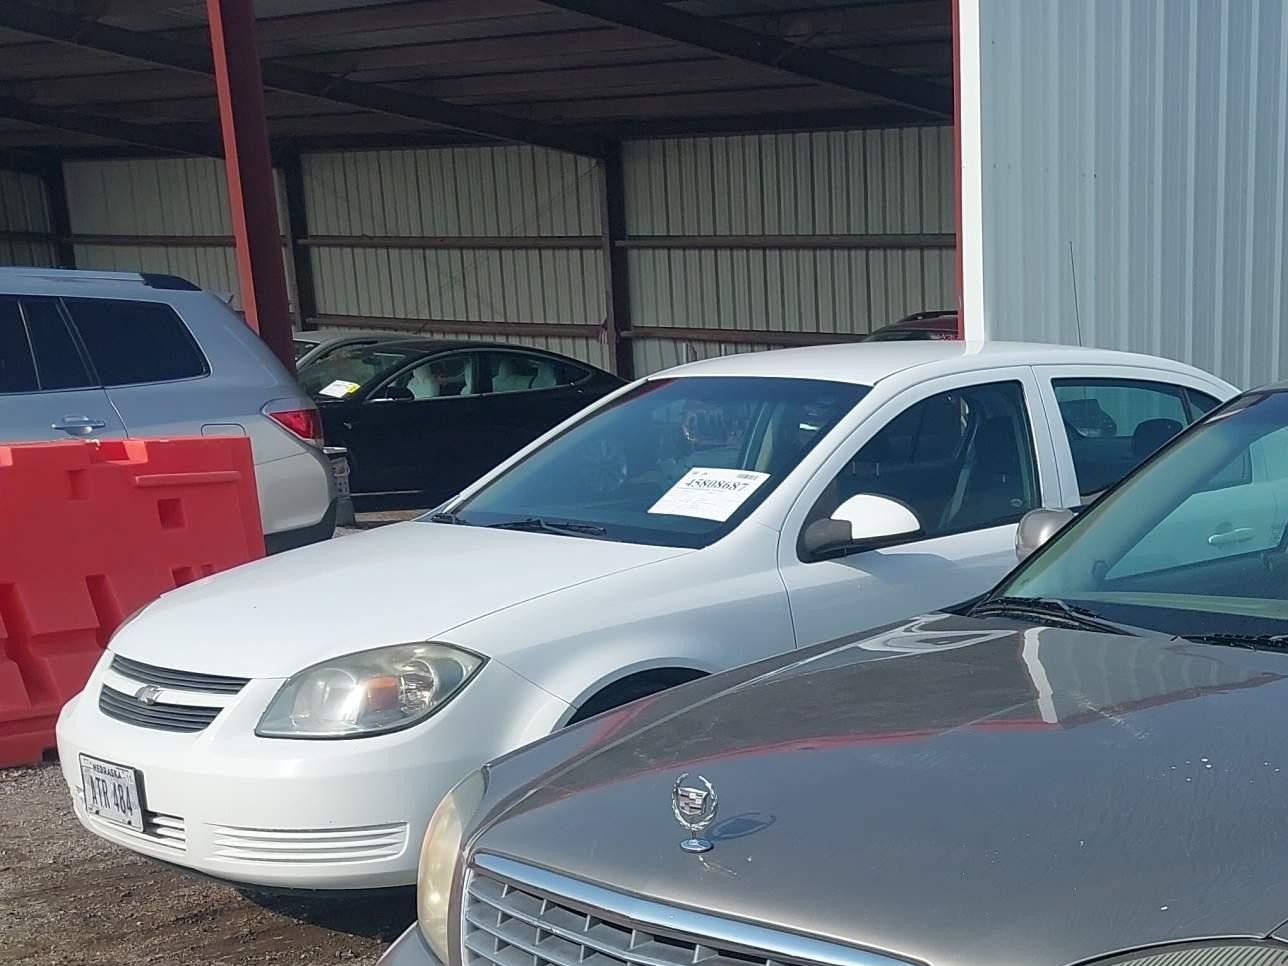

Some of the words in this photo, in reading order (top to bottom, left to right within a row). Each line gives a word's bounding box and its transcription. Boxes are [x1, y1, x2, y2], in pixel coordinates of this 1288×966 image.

[92, 763, 122, 779] NEBRASKA
[90, 776, 111, 809] ATR
[112, 782, 133, 816] 484
